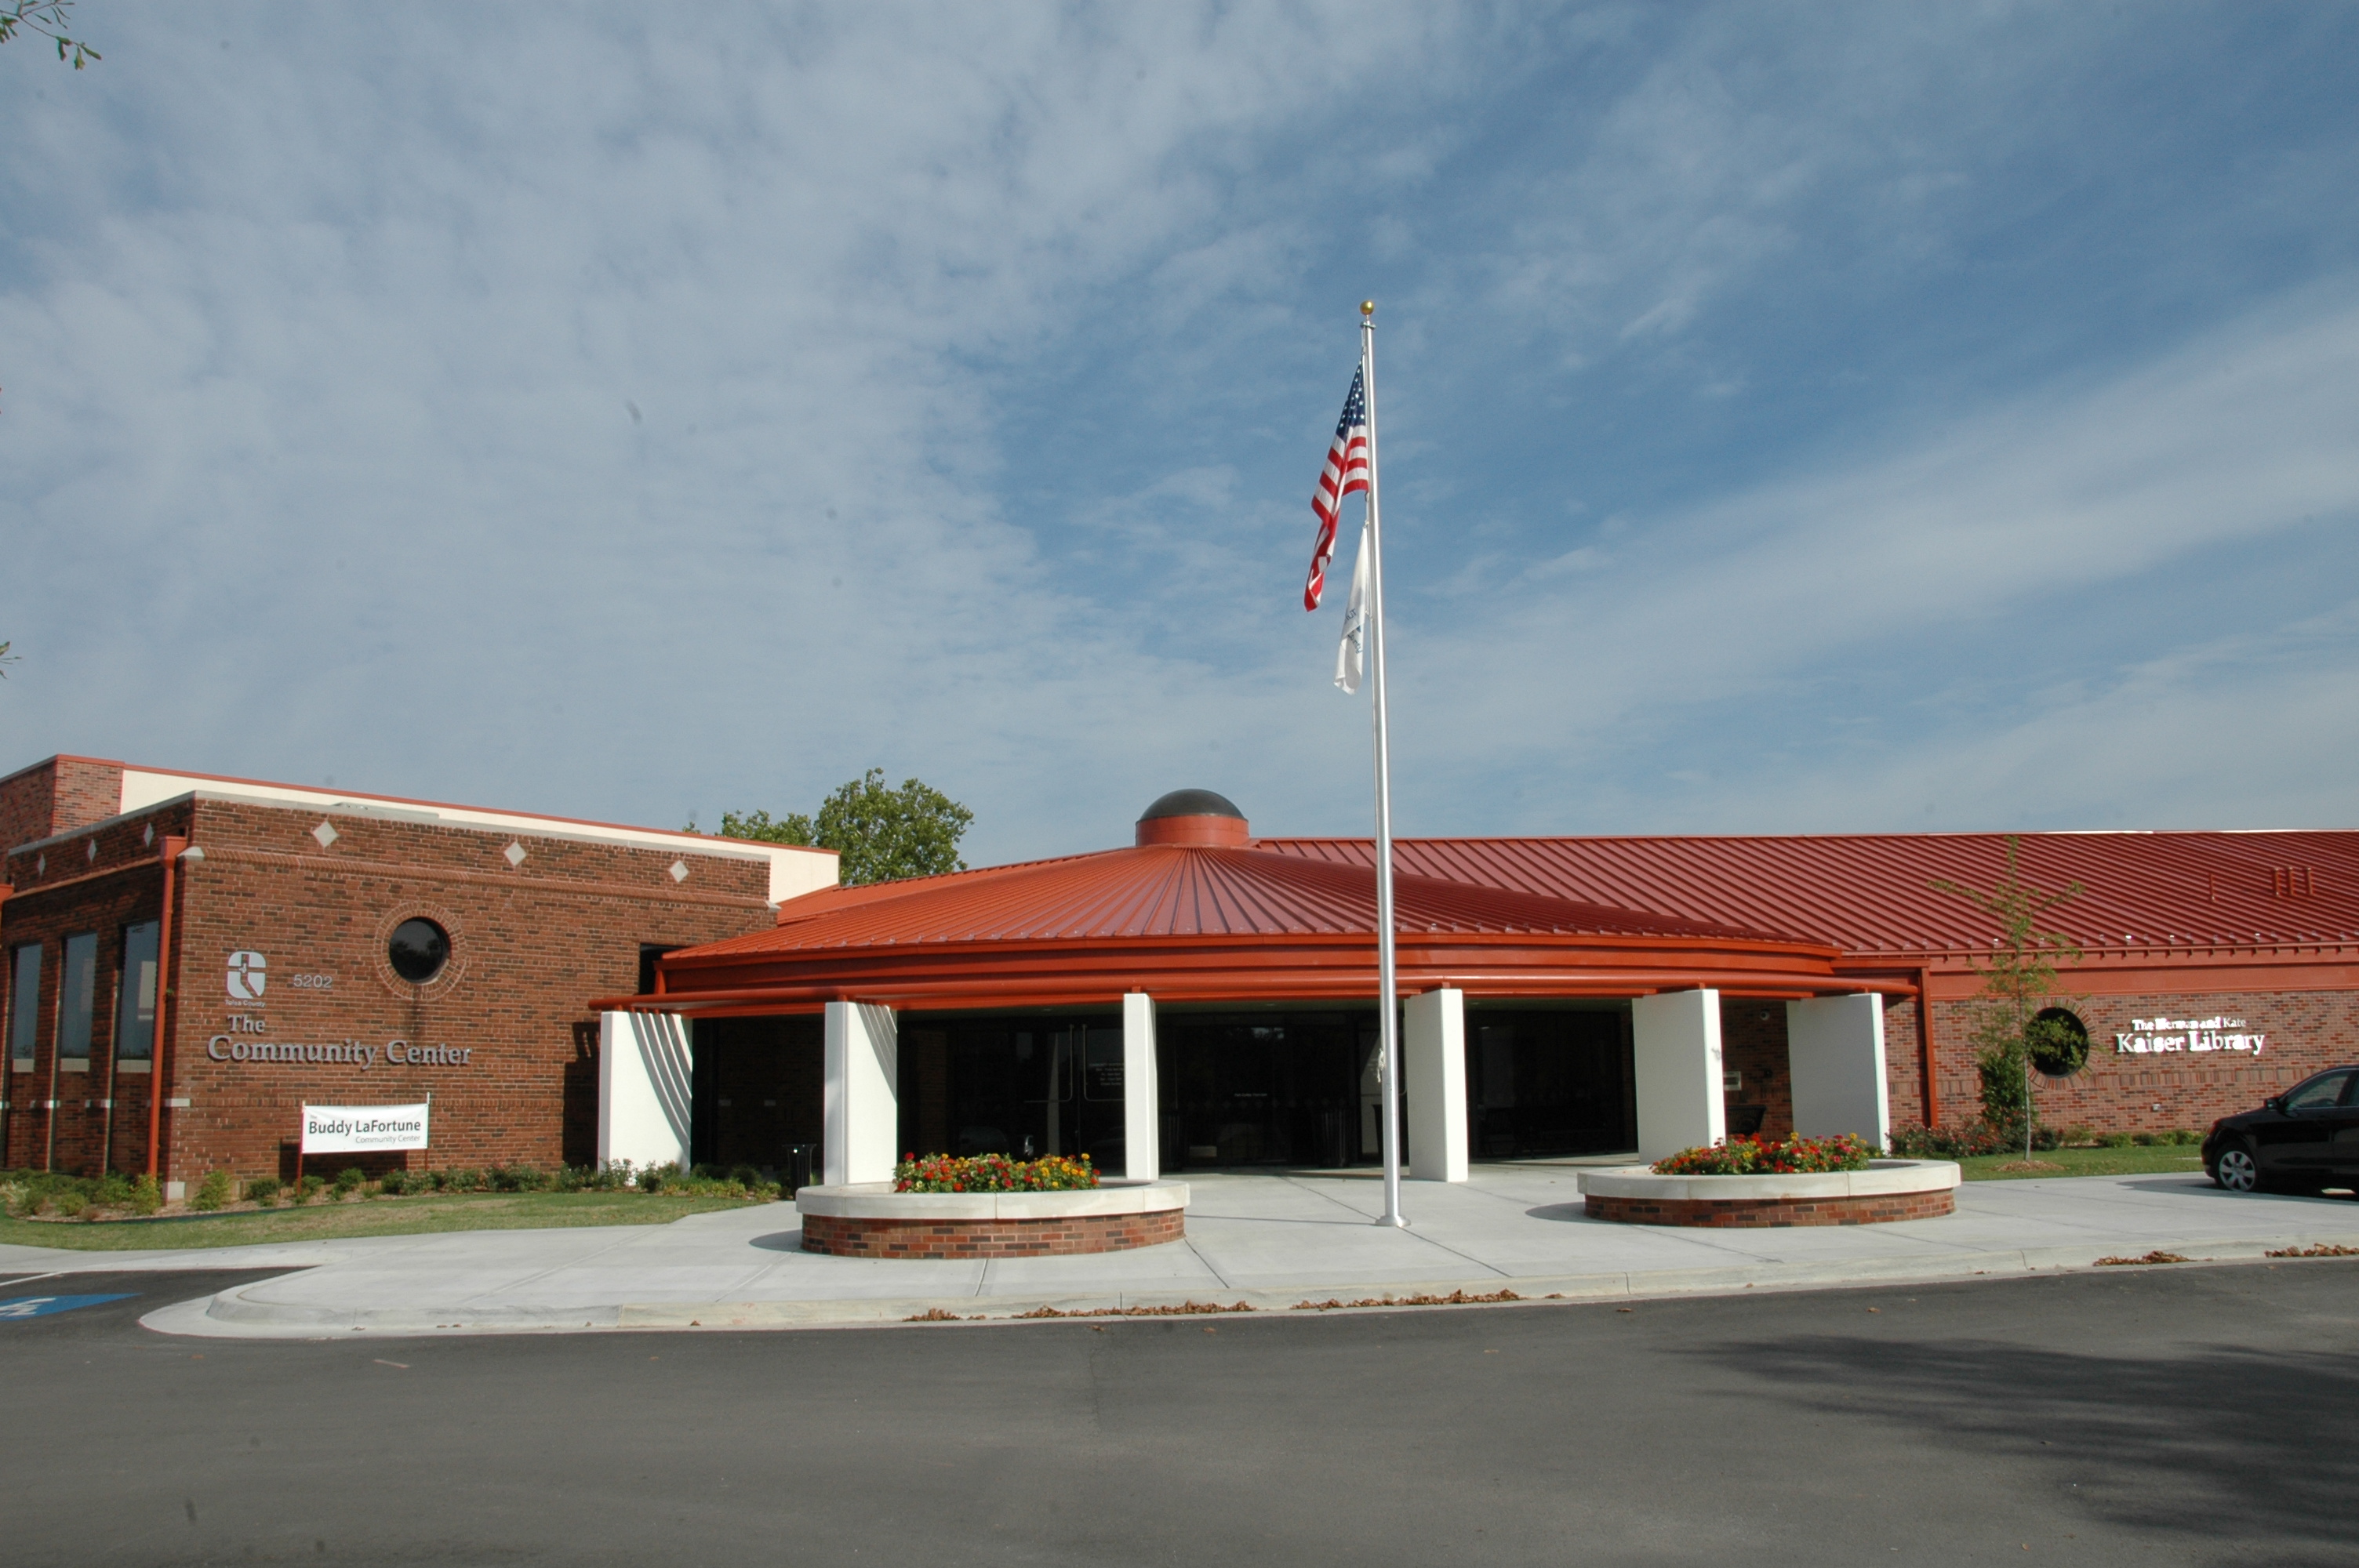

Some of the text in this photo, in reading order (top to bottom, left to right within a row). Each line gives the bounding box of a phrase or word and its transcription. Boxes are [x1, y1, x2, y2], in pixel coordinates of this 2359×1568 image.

[293, 975, 333, 989] 5202
[227, 1015, 266, 1033] The
[2132, 1019, 2154, 1031] The
[2199, 1016, 2222, 1029] and
[2223, 1017, 2247, 1028] Kate
[2116, 1030, 2264, 1055] Kaiser Library
[208, 1036, 472, 1070] Community Center
[309, 1120, 421, 1136] Buddy LaFortune
[355, 1134, 420, 1145] Community Center
